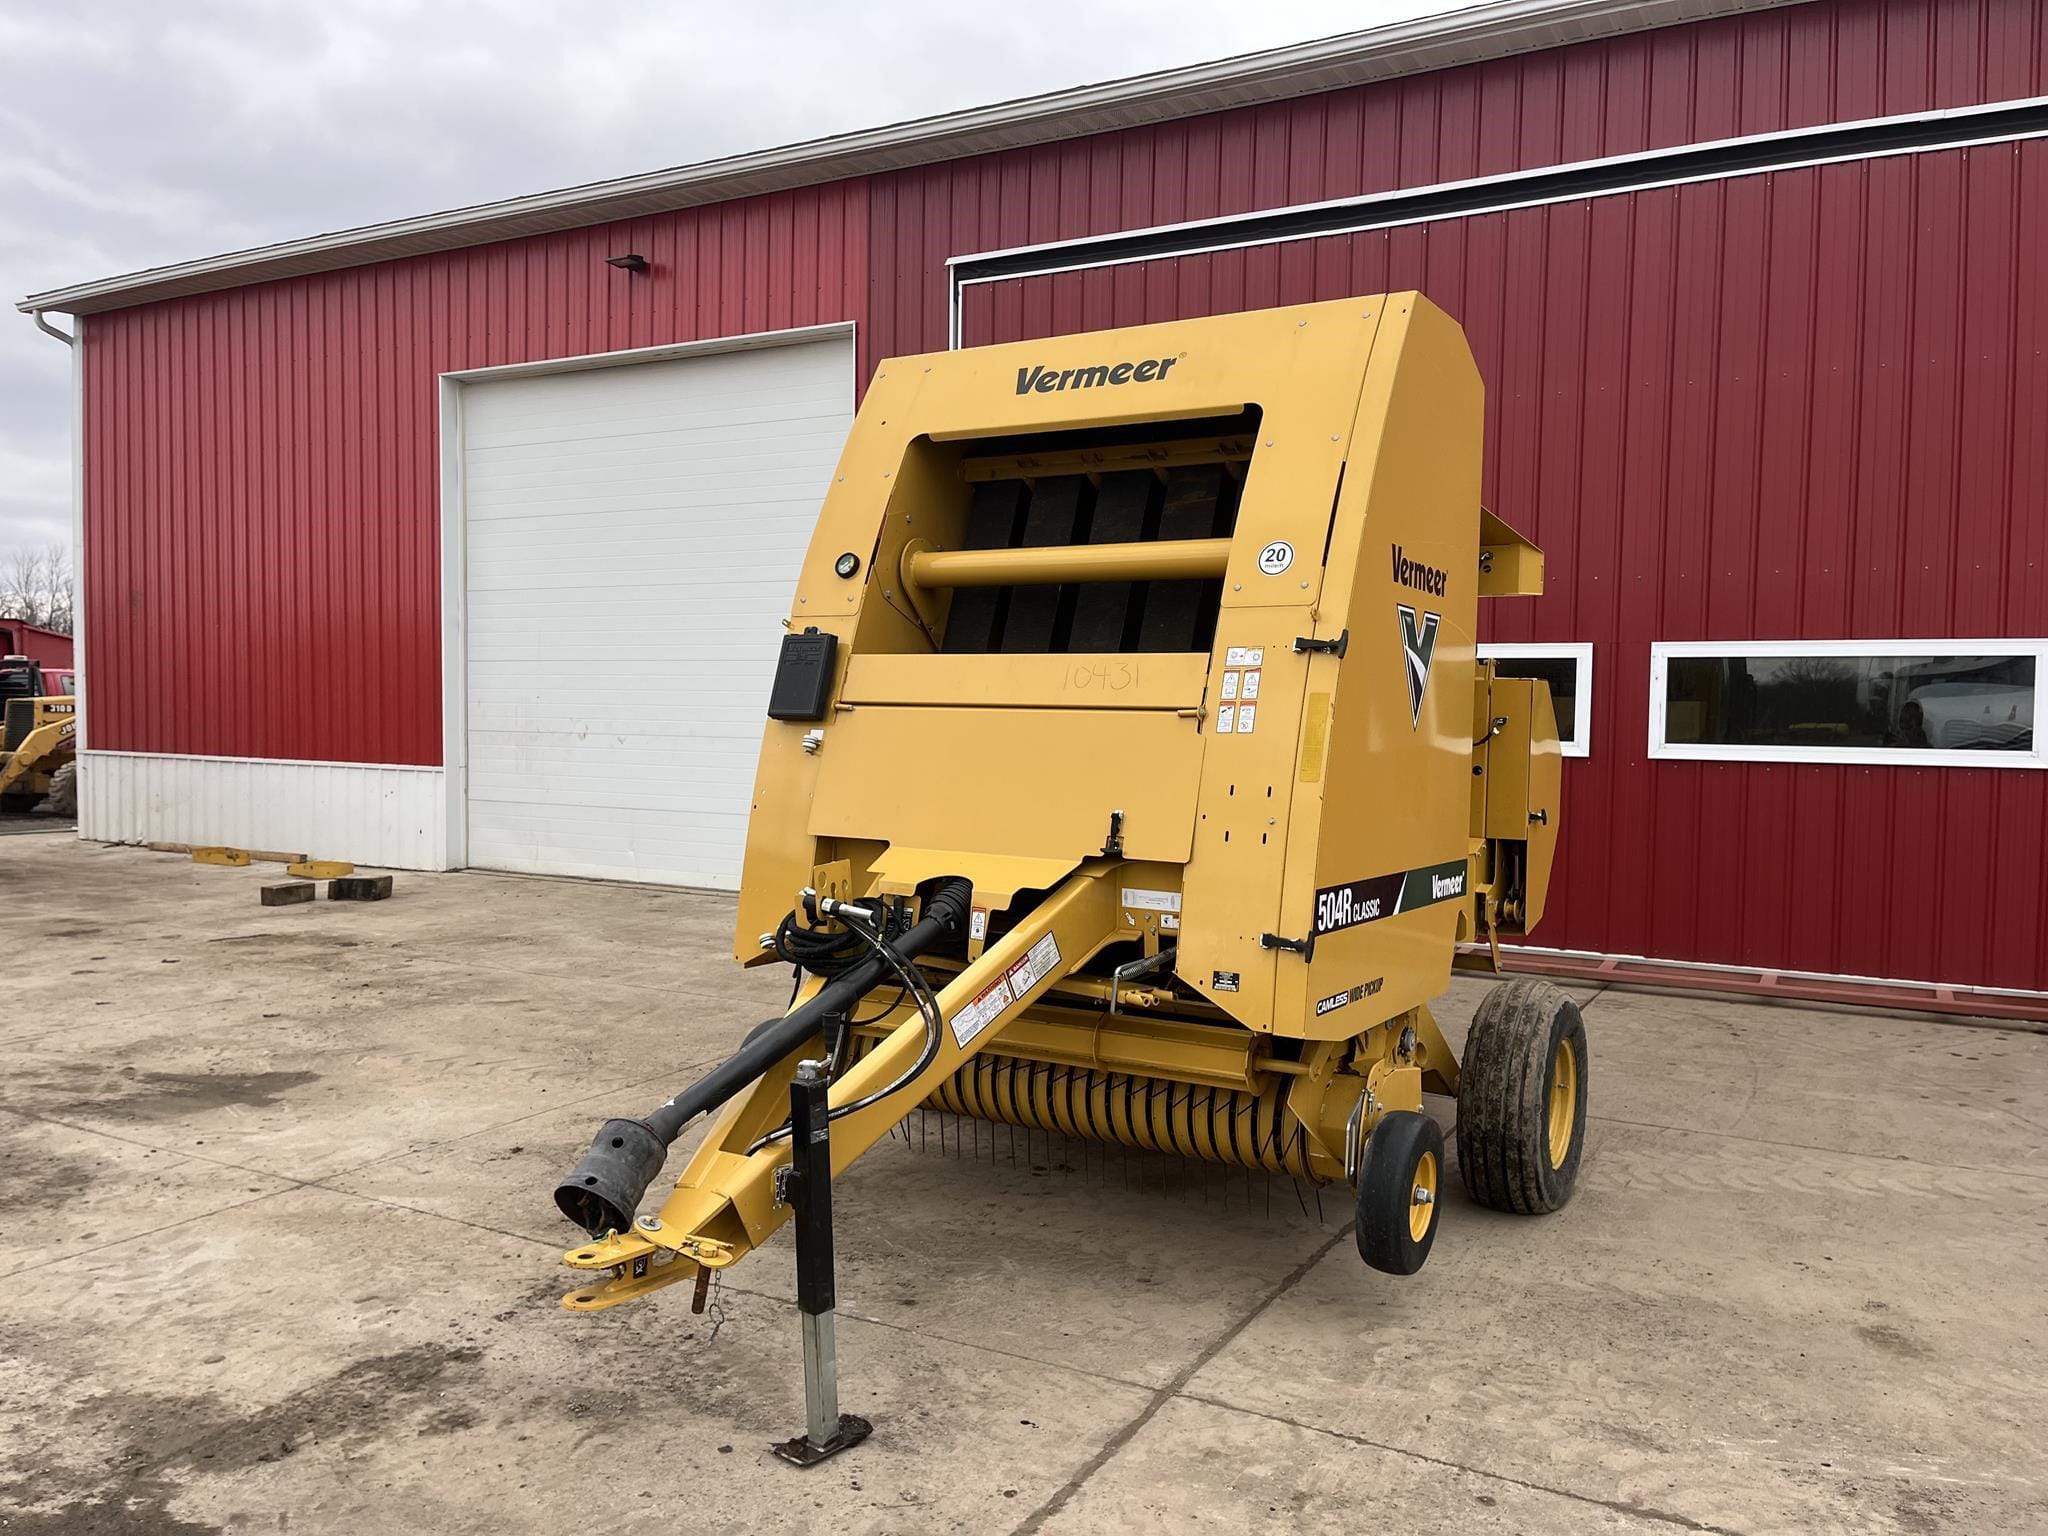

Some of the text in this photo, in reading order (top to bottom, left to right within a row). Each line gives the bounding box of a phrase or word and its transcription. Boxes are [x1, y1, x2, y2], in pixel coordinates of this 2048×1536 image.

[1016, 358, 1178, 395] Vermeer
[1264, 548, 1286, 562] 20
[1391, 543, 1447, 598] Vermeer
[1063, 663, 1140, 690] 10431
[1431, 873, 1463, 899] Vermeer
[1317, 888, 1380, 932] 504R CLASSIC
[1317, 977, 1384, 1014] CAMLESS WIDE PICKUP
